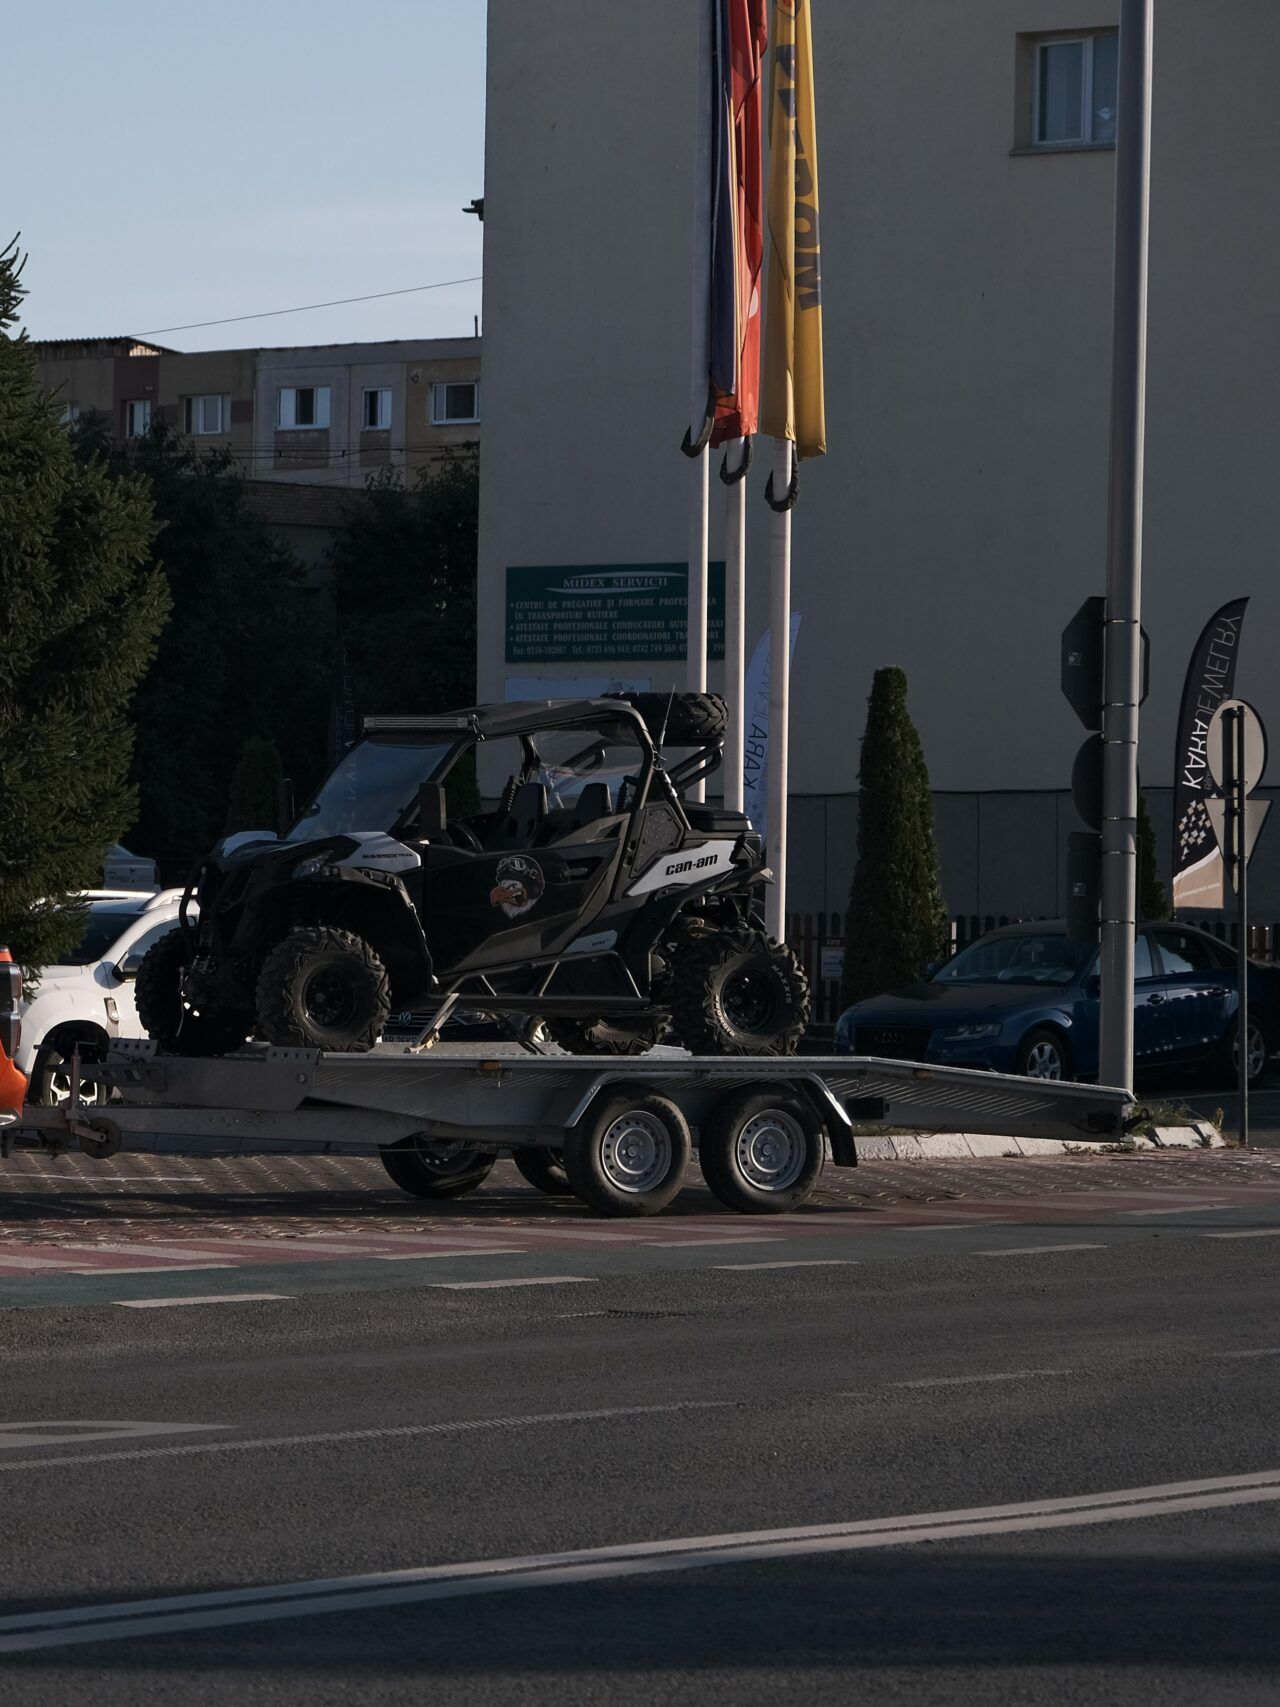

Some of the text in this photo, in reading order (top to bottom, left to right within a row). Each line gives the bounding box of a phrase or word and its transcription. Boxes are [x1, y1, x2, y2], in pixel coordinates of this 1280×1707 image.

[563, 577, 668, 588] MIDEX SERVICII
[665, 854, 718, 876] can-am
